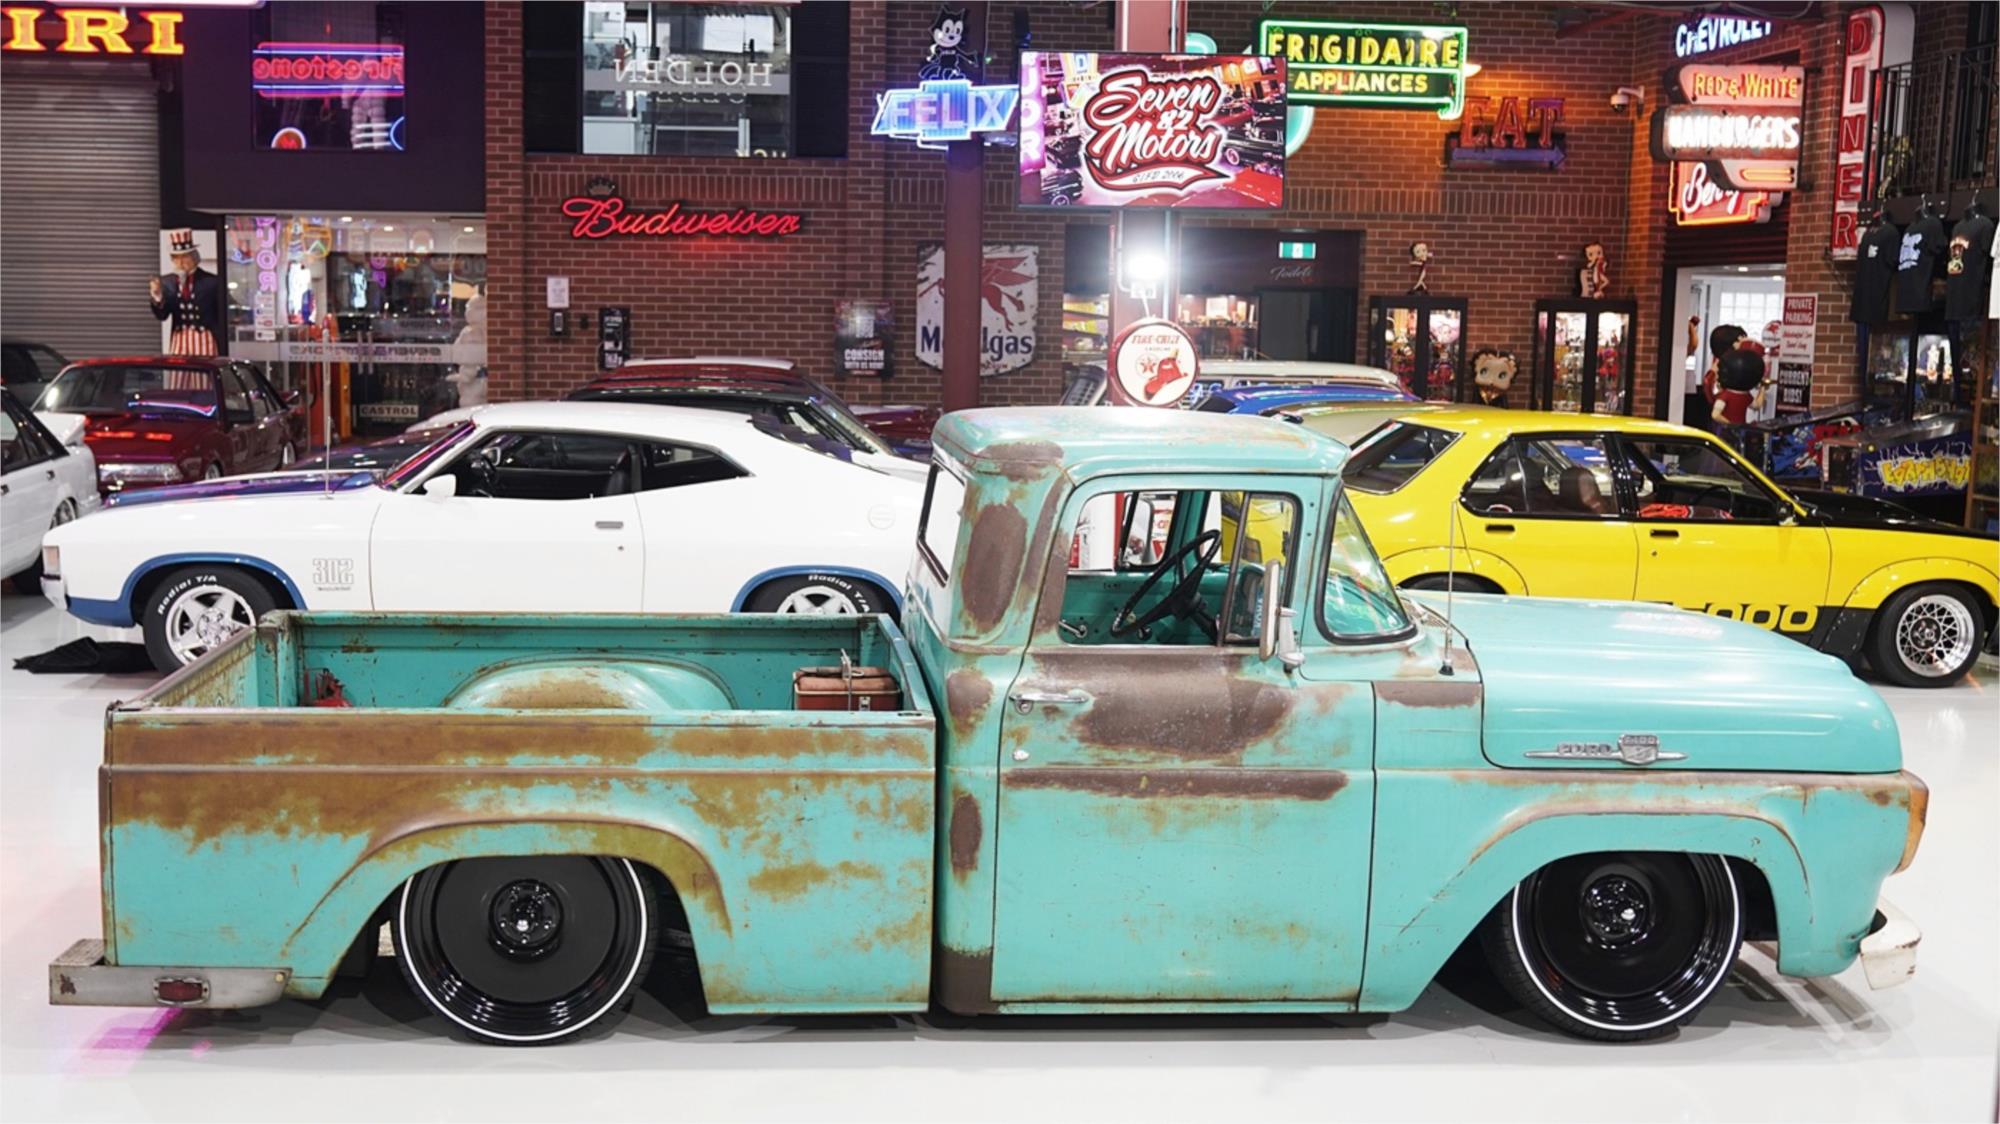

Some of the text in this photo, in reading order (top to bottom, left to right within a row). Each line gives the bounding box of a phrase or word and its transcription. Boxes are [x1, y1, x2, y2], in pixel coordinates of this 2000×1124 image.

[1269, 33, 1459, 67] FRIGIDAIRE
[1294, 71, 1428, 93] APPLIANCES
[1694, 73, 1797, 98] RED & WHITE
[890, 91, 1005, 130] FELIX
[1090, 76, 1211, 124] Seven
[1156, 109, 1194, 130] 82
[1460, 96, 1565, 148] EAT
[1668, 115, 1800, 148] HAMBURGERS
[1834, 17, 1873, 248] DINER
[1092, 120, 1218, 170] Motors
[563, 198, 800, 238] Budweiser
[1784, 311, 1813, 323] PARKING
[1786, 299, 1813, 310] PRIVATE
[844, 349, 885, 361] CONSIGN
[921, 325, 1033, 362] Mlgas
[361, 406, 417, 415] CASTROL
[313, 558, 354, 584] 302
[158, 575, 217, 615] Radial T/A
[808, 574, 870, 613] Radial T/A
[1673, 603, 1819, 632] 000
[1556, 743, 1612, 757] FORD
